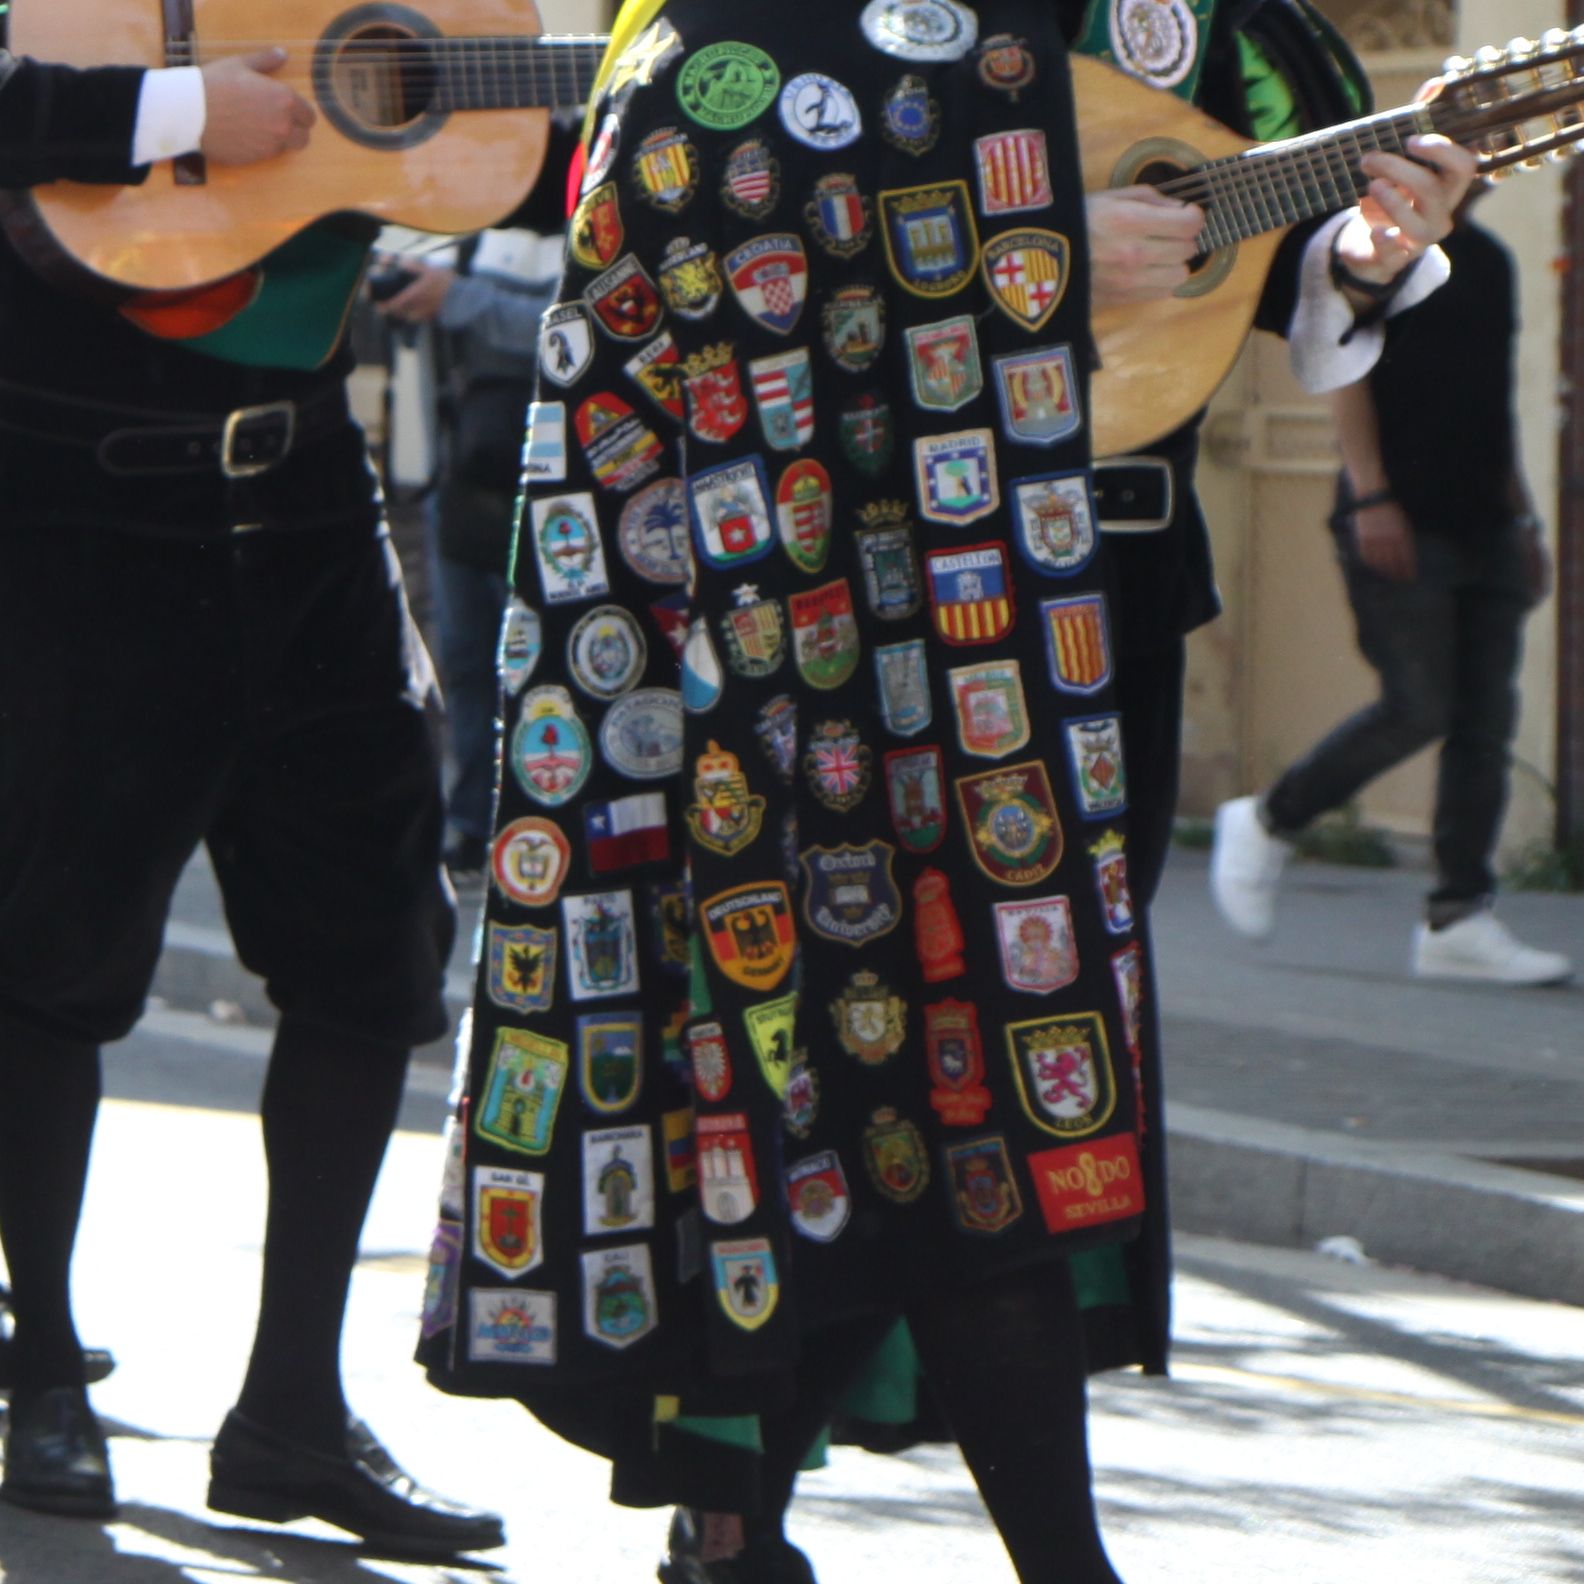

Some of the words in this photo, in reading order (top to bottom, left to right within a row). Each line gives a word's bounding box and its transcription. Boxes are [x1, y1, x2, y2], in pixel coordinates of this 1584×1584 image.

[735, 238, 793, 264] CROATIA
[819, 851, 876, 872] Oxford
[1063, 1195, 1132, 1220] SEVILLA
